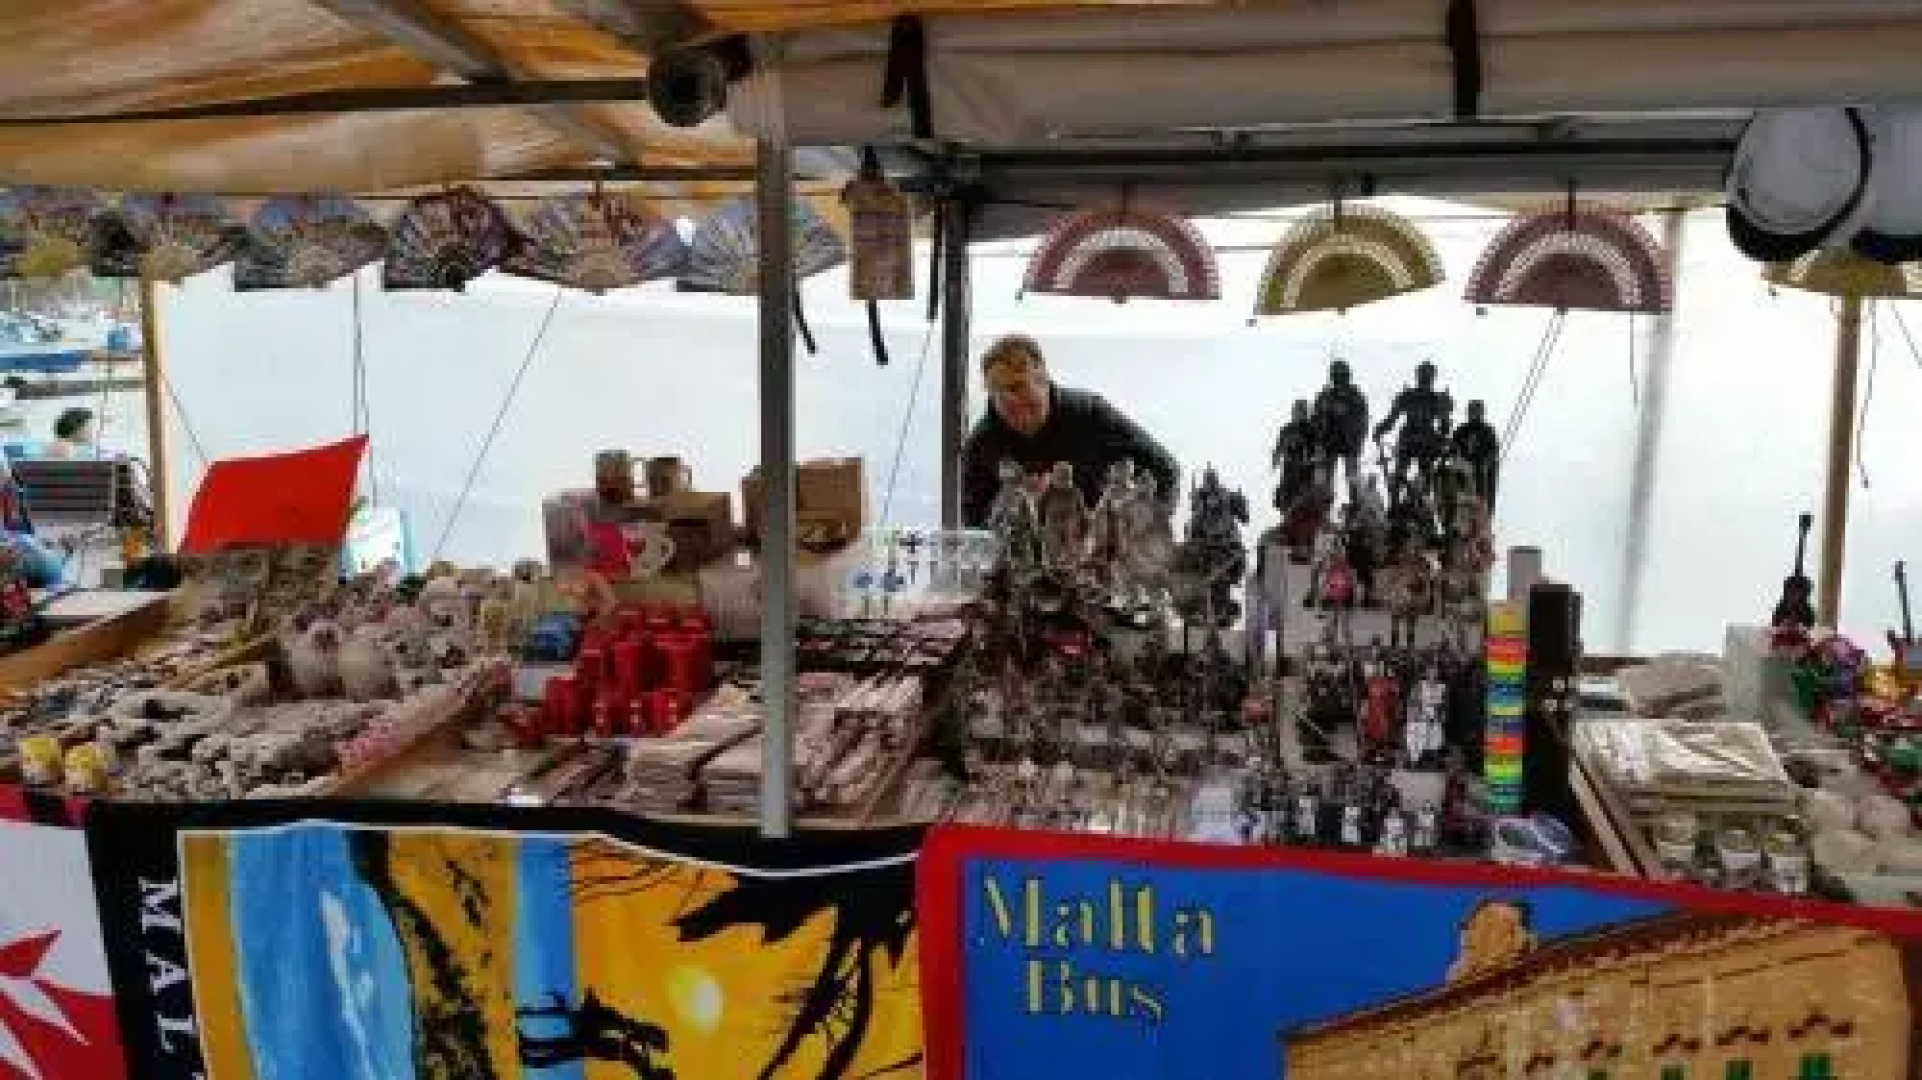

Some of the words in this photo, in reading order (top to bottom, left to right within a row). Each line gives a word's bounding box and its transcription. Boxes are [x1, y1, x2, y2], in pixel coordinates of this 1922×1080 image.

[978, 873, 1215, 956] Malta
[138, 876, 206, 1080] MAL
[1024, 958, 1166, 1025] Bus
